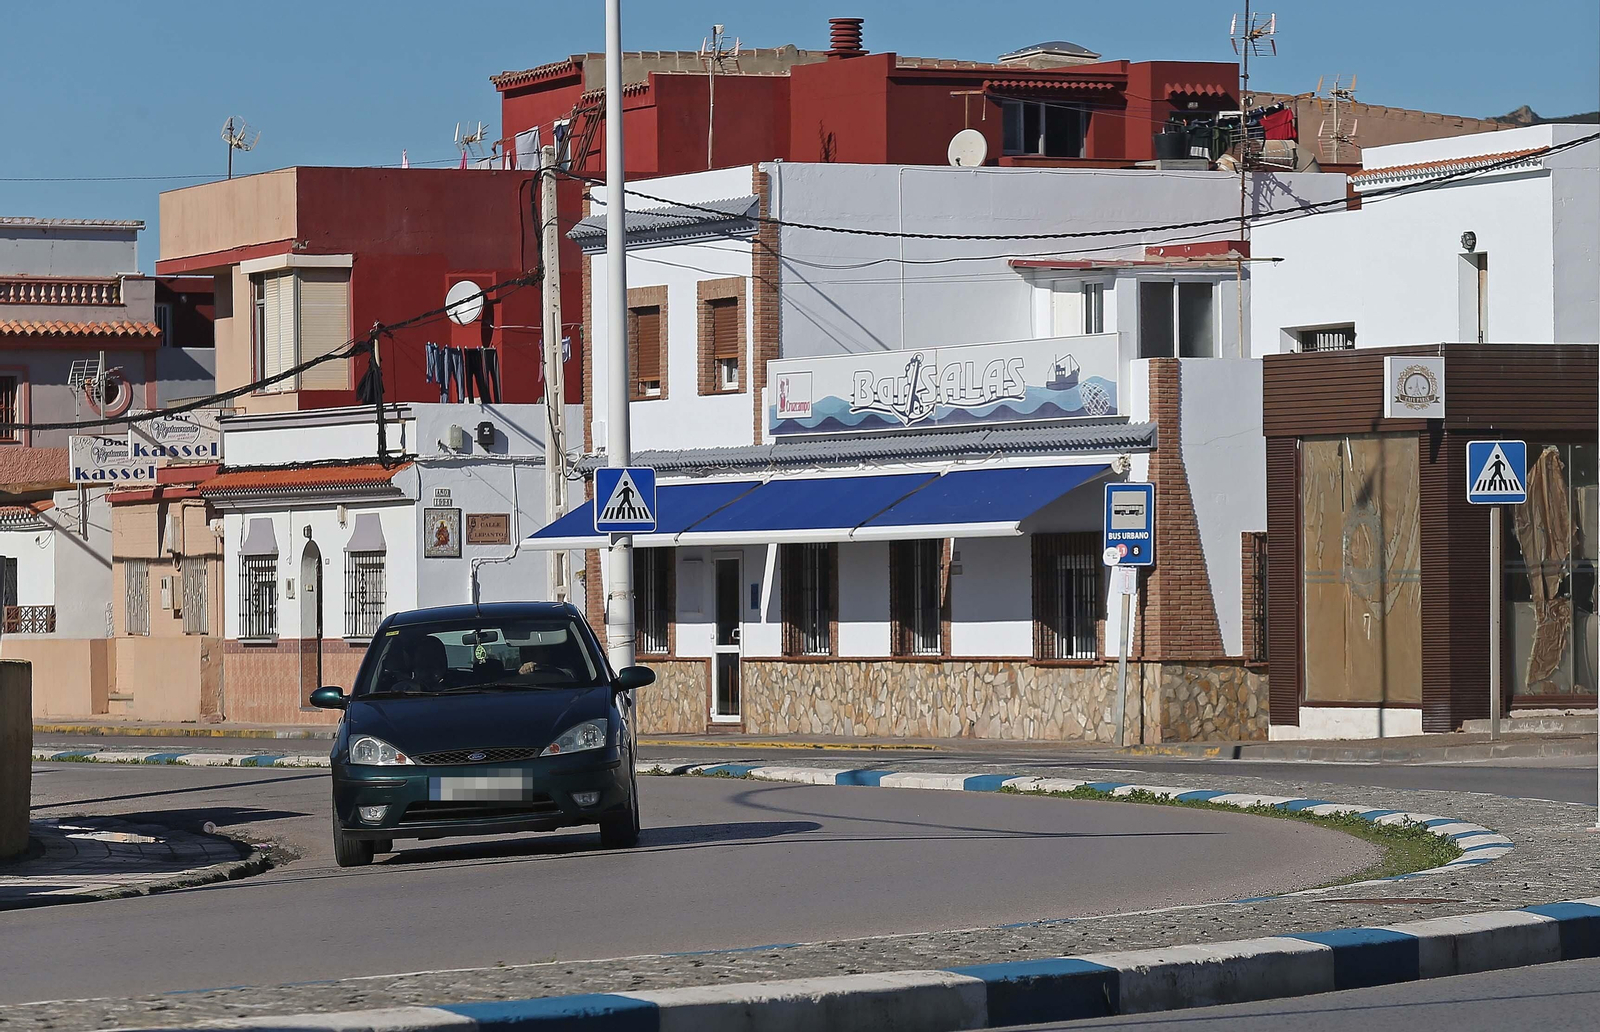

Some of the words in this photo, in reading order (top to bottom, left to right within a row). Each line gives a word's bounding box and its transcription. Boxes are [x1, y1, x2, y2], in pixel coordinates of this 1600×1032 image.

[853, 370, 908, 407] Bar
[920, 357, 1026, 407] SALAS
[785, 400, 811, 413] Cruzcampo
[163, 413, 190, 422] Bar
[133, 442, 217, 457] kassel
[75, 466, 155, 480] kassel
[1108, 532, 1121, 540] BUS
[1122, 531, 1149, 540] URBANO
[1133, 547, 1139, 555] 8
